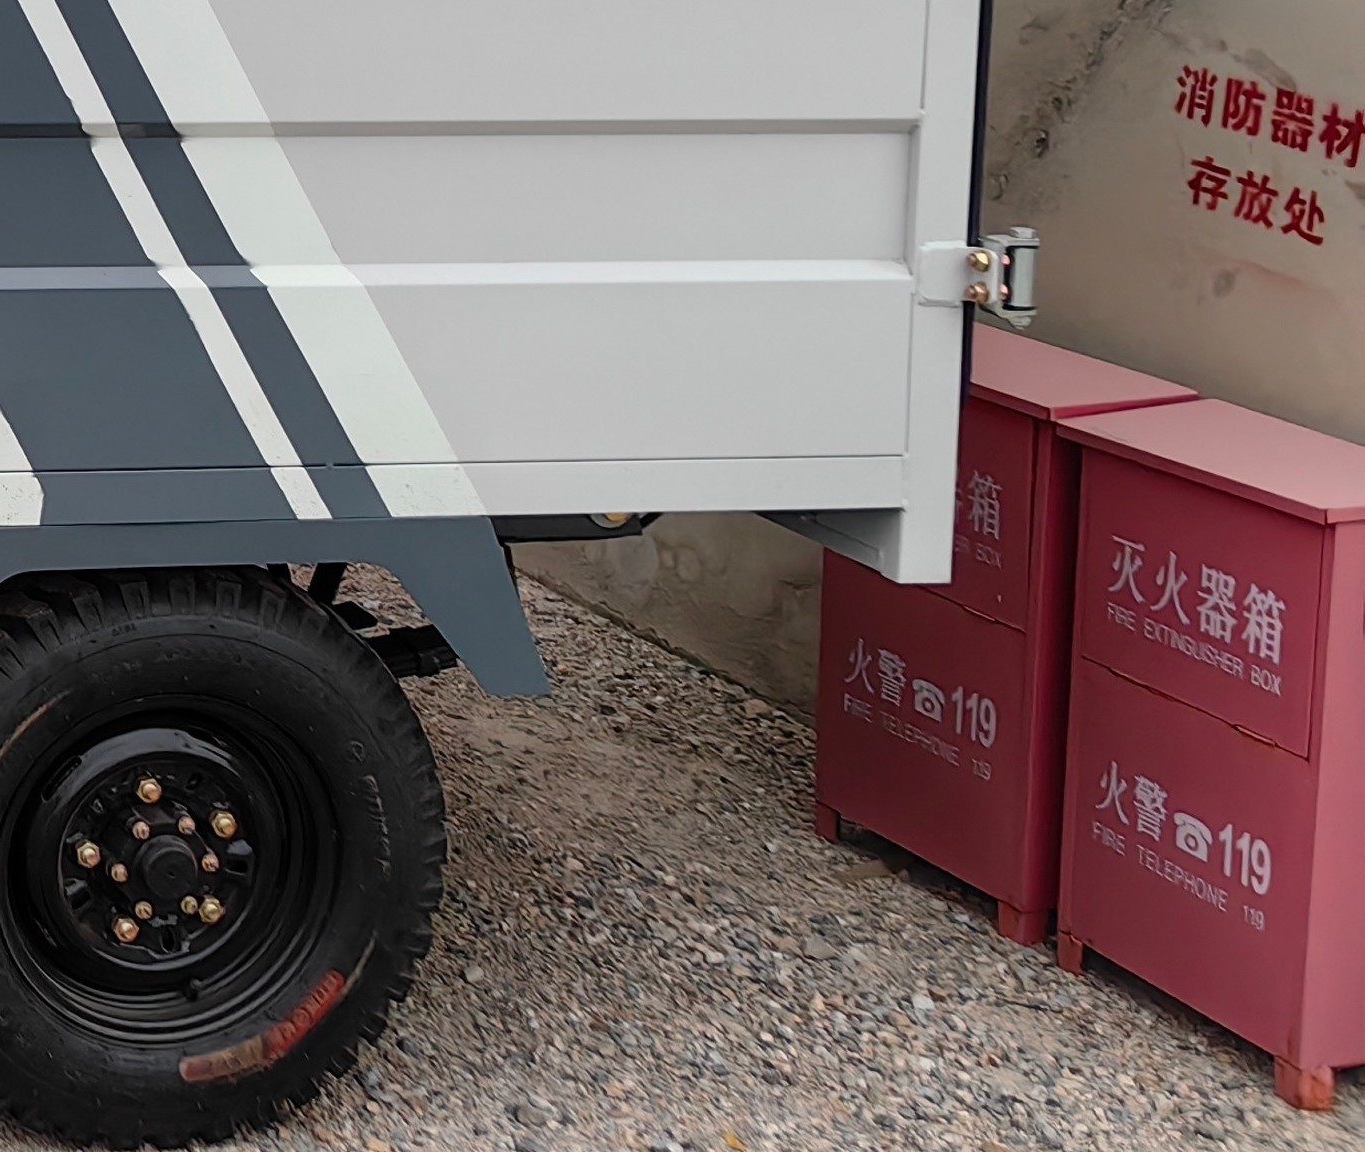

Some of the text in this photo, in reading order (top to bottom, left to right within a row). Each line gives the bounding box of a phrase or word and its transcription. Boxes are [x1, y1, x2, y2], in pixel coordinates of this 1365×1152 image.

[1175, 65, 1365, 168] 消防器材
[1187, 156, 1325, 246] 存放处
[1107, 535, 1286, 665] 灭火器箱
[1144, 617, 1244, 680] EXTINGUISHER
[1250, 664, 1281, 696] BOX
[1092, 821, 1126, 856] FIRE
[1136, 844, 1229, 912] TELEPHONE
